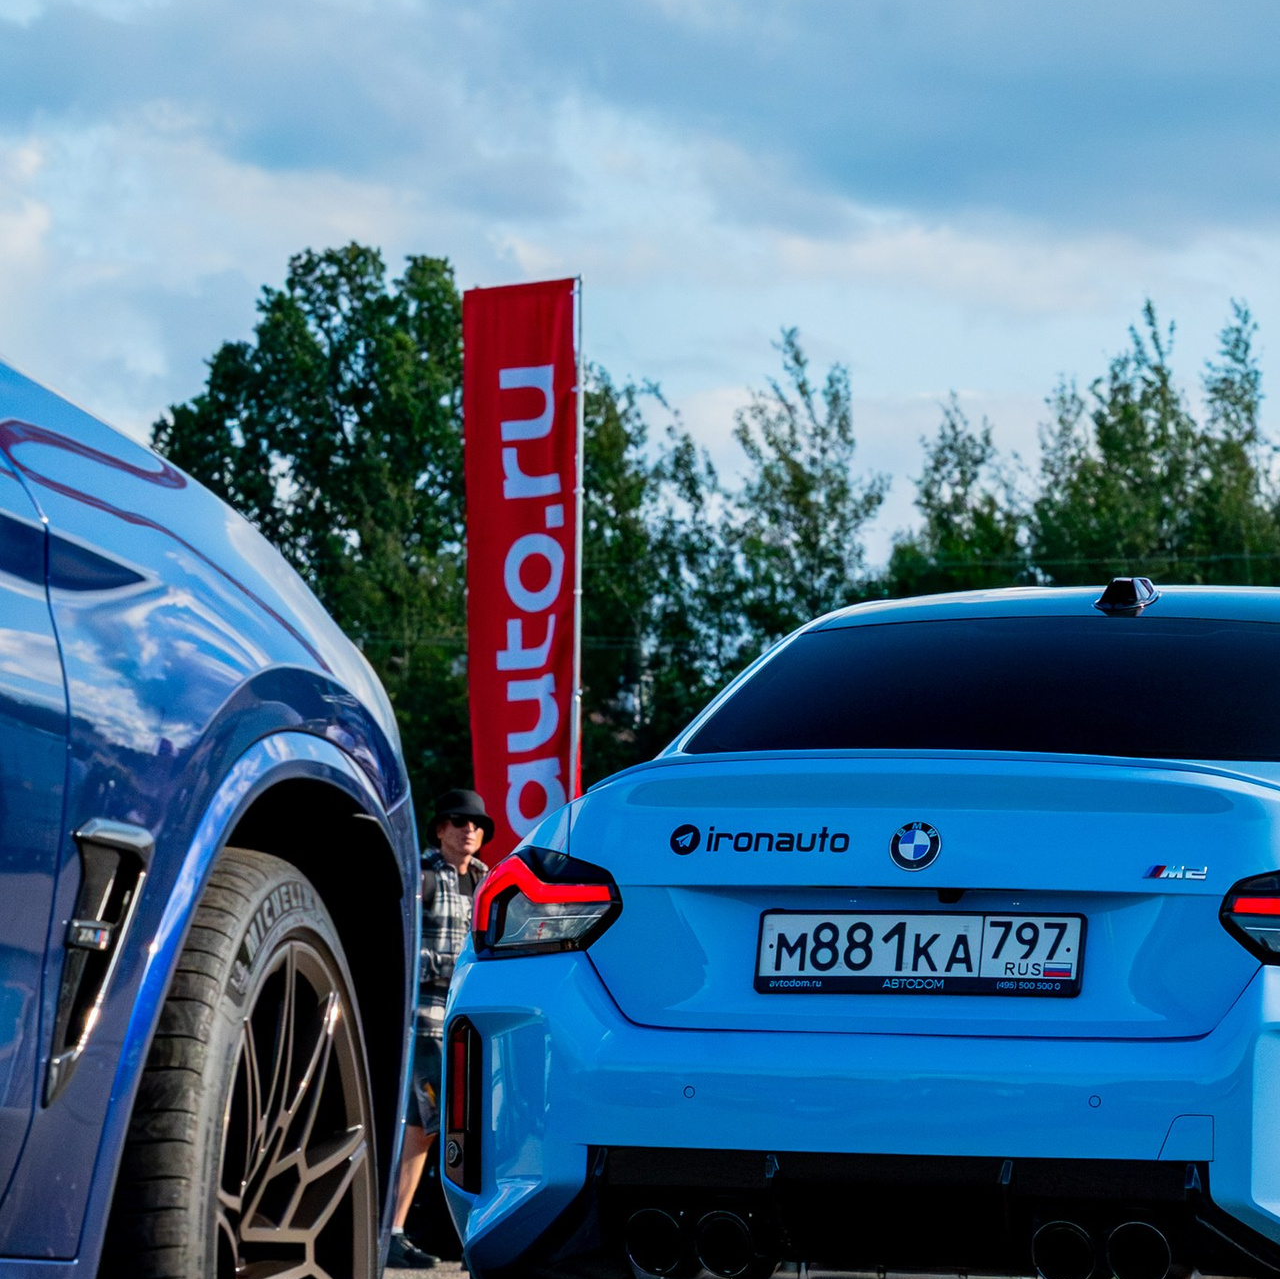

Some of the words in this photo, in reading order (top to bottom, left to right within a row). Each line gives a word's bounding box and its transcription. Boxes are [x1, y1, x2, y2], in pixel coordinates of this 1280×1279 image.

[496, 363, 566, 839] auto.ru
[896, 822, 938, 838] BMW
[706, 826, 849, 853] ironauto
[989, 920, 1068, 961] 797
[1004, 961, 1042, 976] RUS
[768, 978, 822, 988] avtodom.ru
[996, 980, 1017, 990] (495)
[1018, 981, 1035, 990] 500
[1037, 981, 1053, 991] 500
